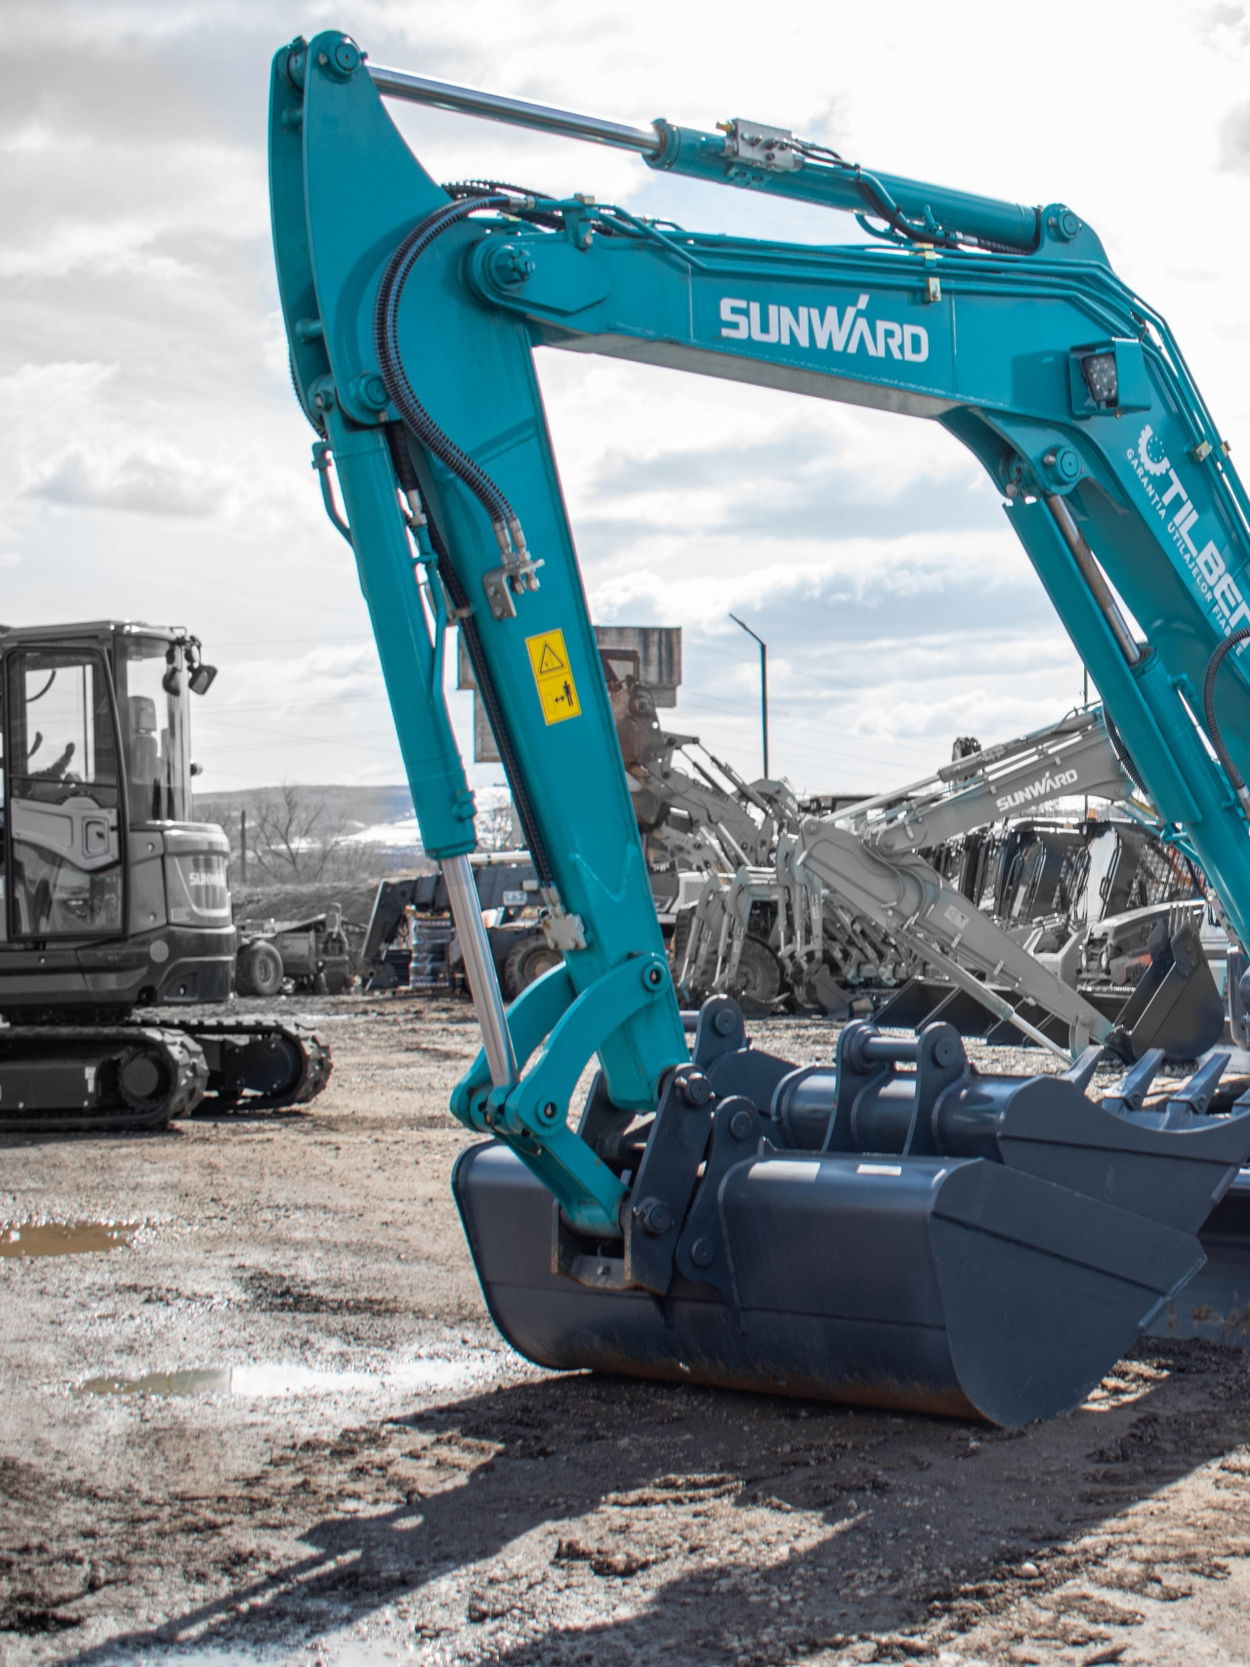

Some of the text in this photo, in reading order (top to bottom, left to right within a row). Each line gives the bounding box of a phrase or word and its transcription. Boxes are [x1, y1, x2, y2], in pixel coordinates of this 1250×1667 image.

[720, 294, 929, 362] SUNWARD
[1167, 521, 1213, 603] UTILAJELOR
[1212, 604, 1244, 657] FIABE
[996, 769, 1078, 812] SUNWARD
